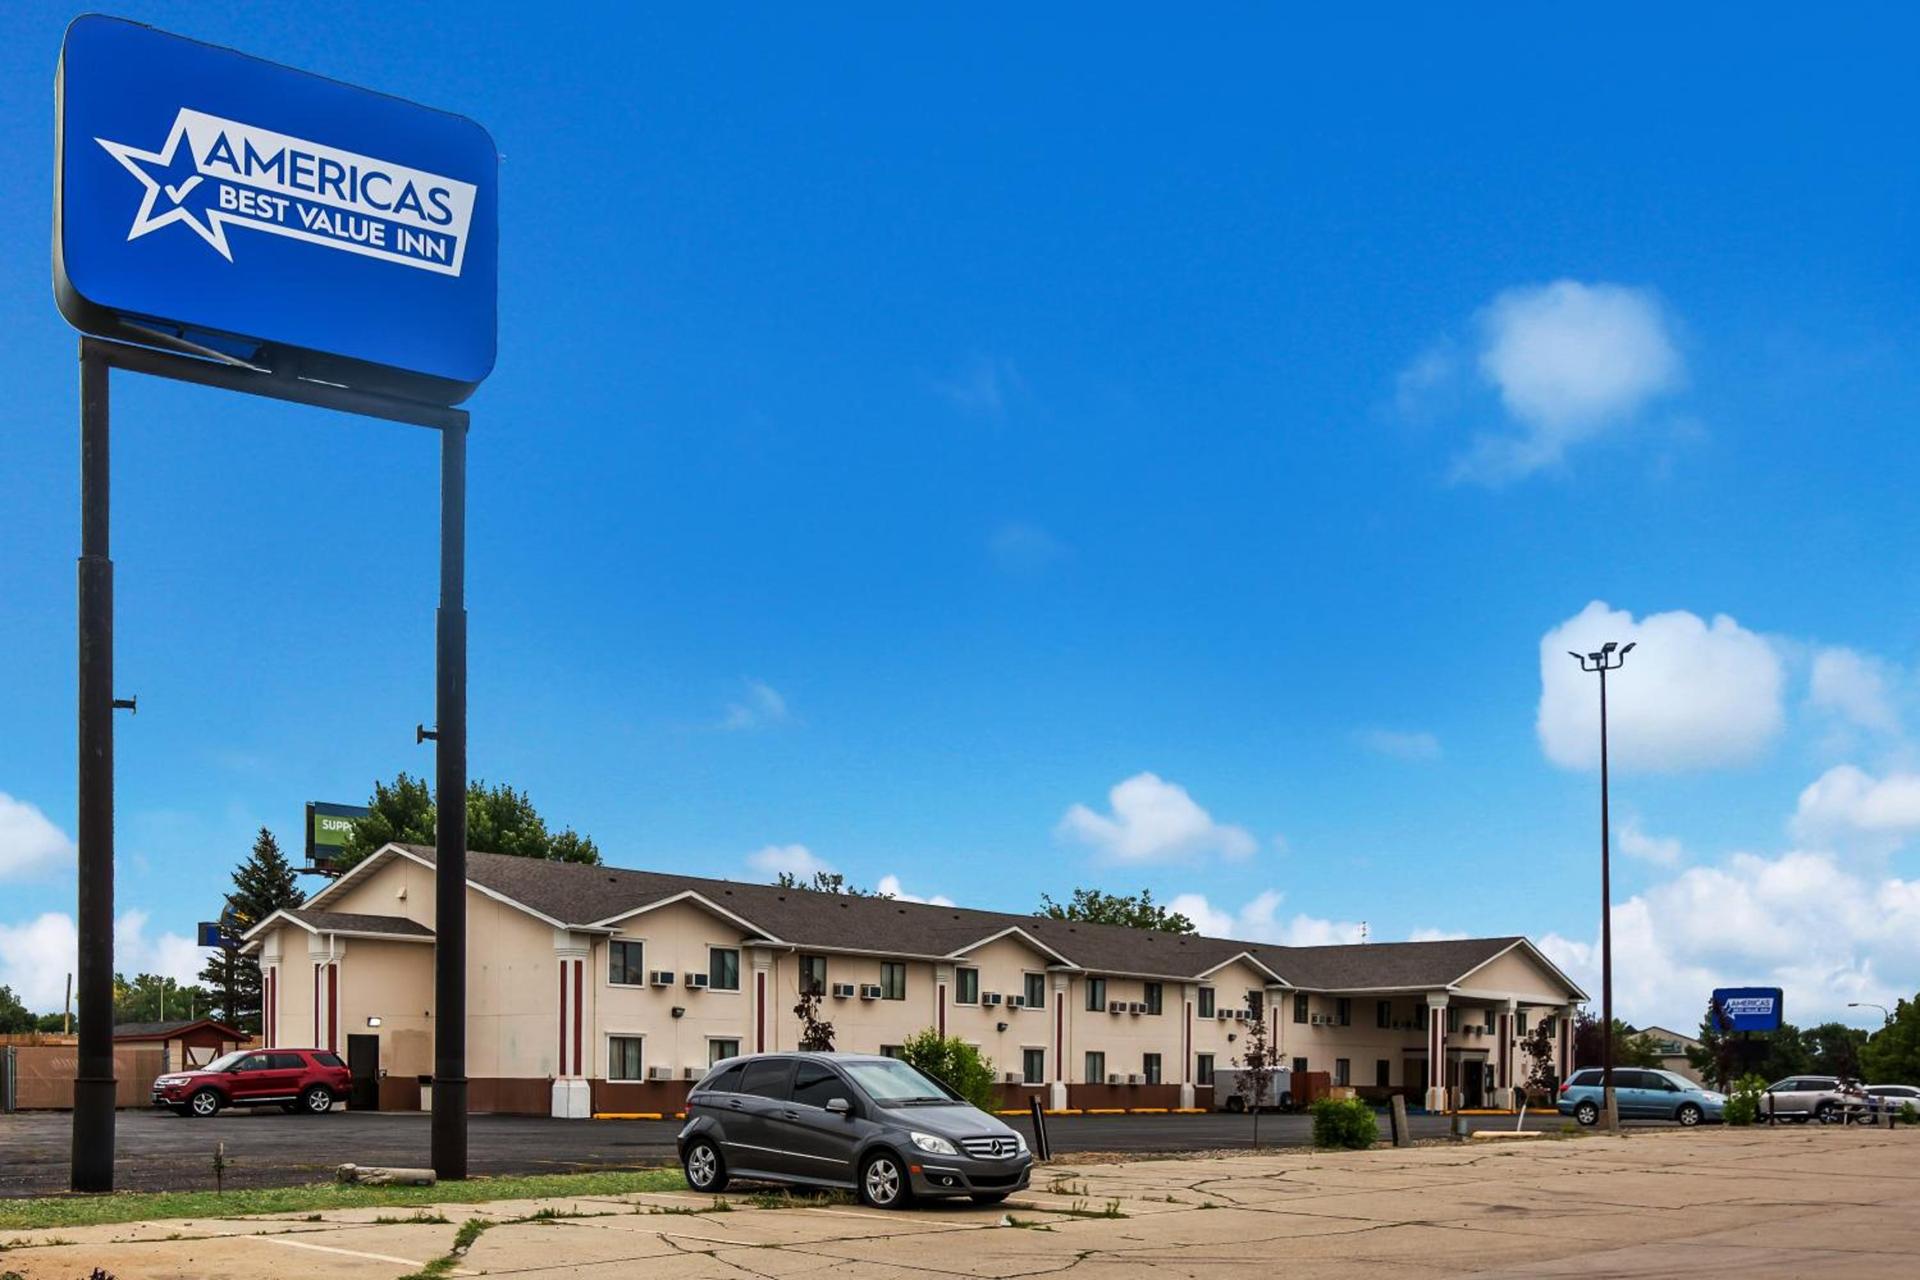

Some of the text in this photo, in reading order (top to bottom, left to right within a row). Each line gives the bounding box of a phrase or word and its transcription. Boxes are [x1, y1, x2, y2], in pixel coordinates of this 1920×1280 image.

[203, 131, 453, 226] AMERICAS
[220, 186, 446, 261] BEST VALUE INN
